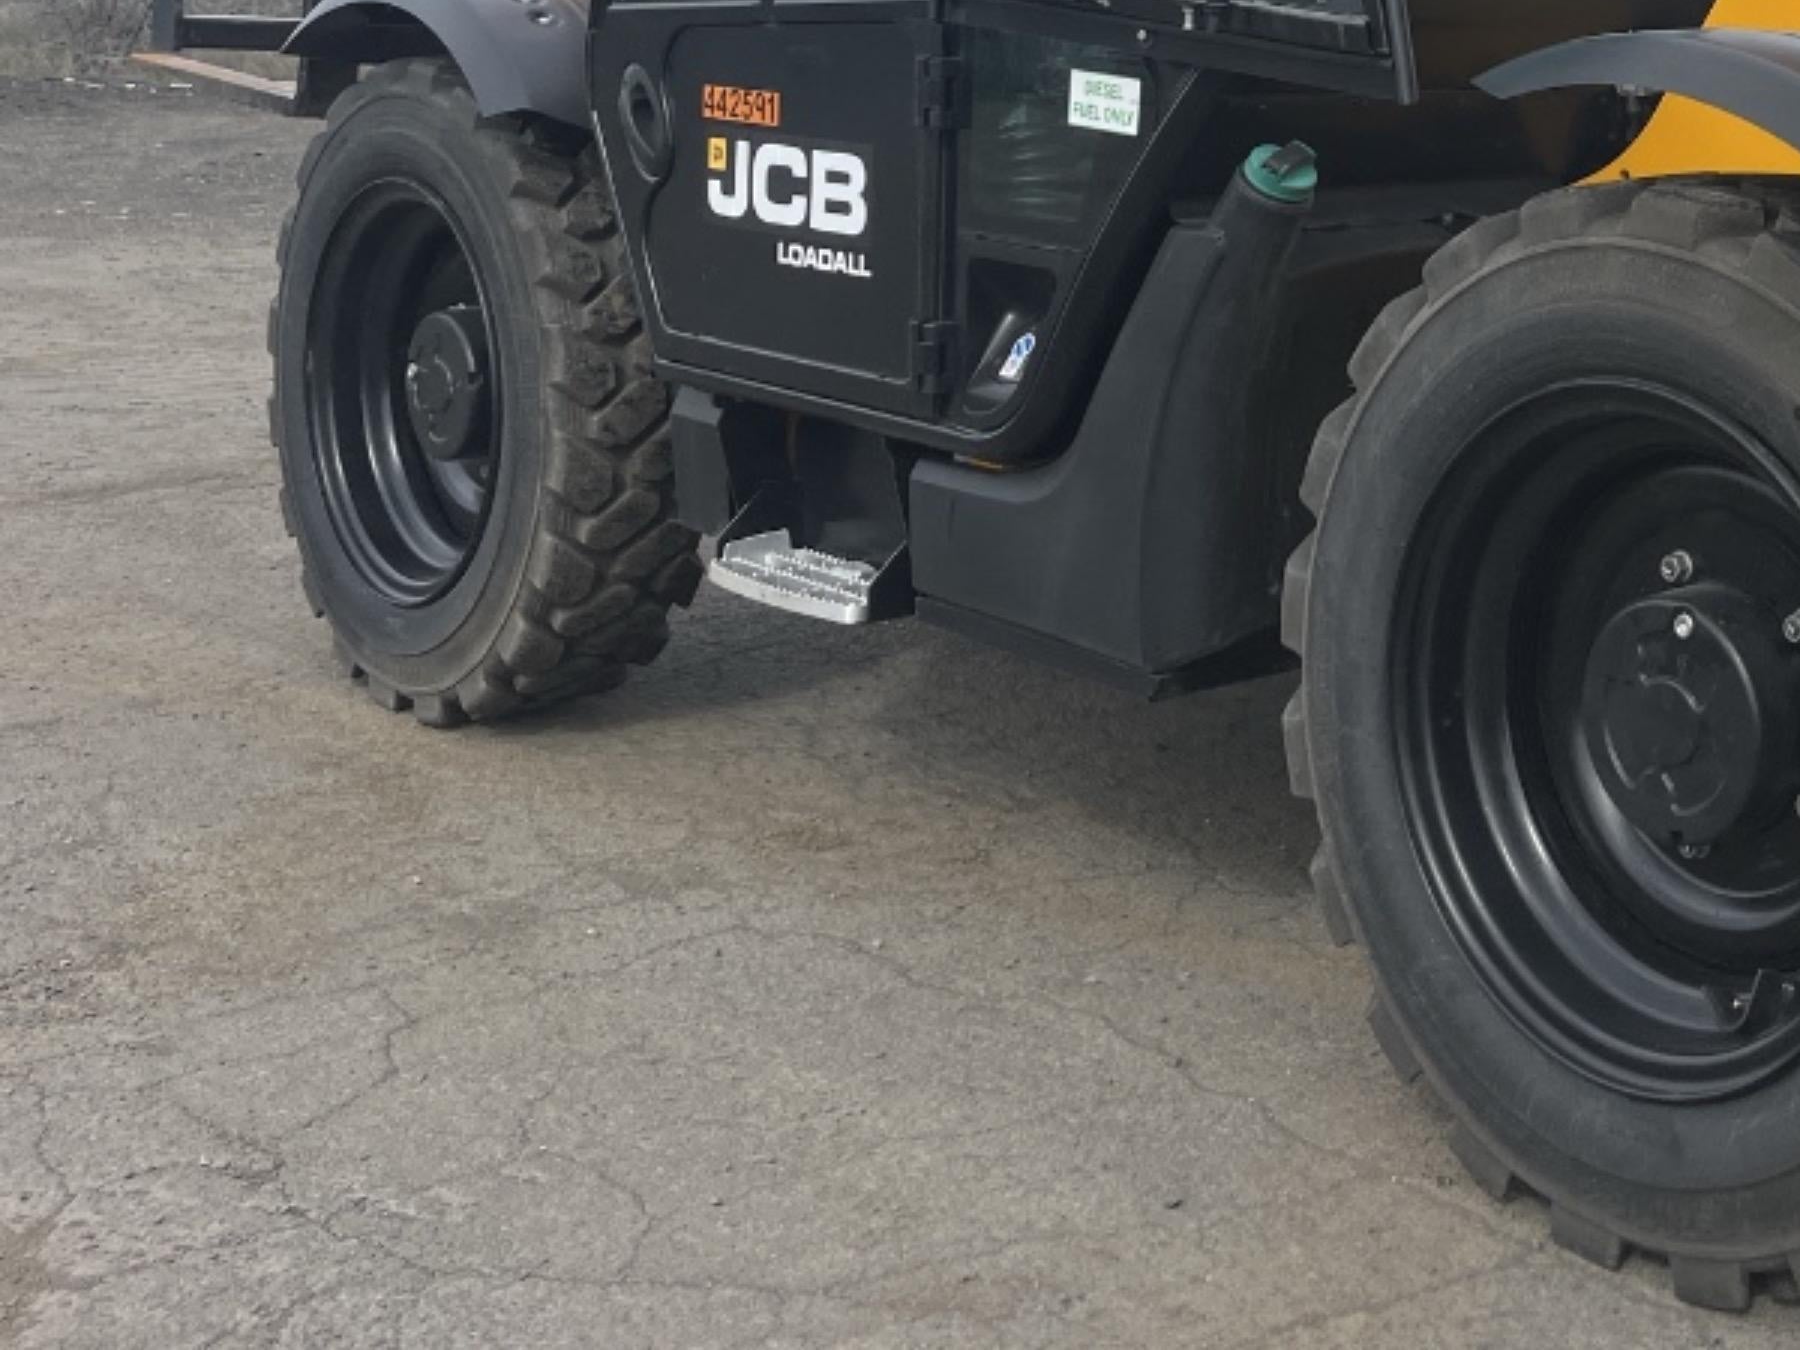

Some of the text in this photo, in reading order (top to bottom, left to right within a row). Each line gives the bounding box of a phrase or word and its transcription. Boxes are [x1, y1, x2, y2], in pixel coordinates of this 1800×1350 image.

[704, 86, 776, 124] 442591
[1085, 80, 1123, 100] DIESEL
[1073, 101, 1135, 127] FUEL ONLY
[707, 139, 868, 236] JCB
[777, 241, 872, 277] LOADALL
